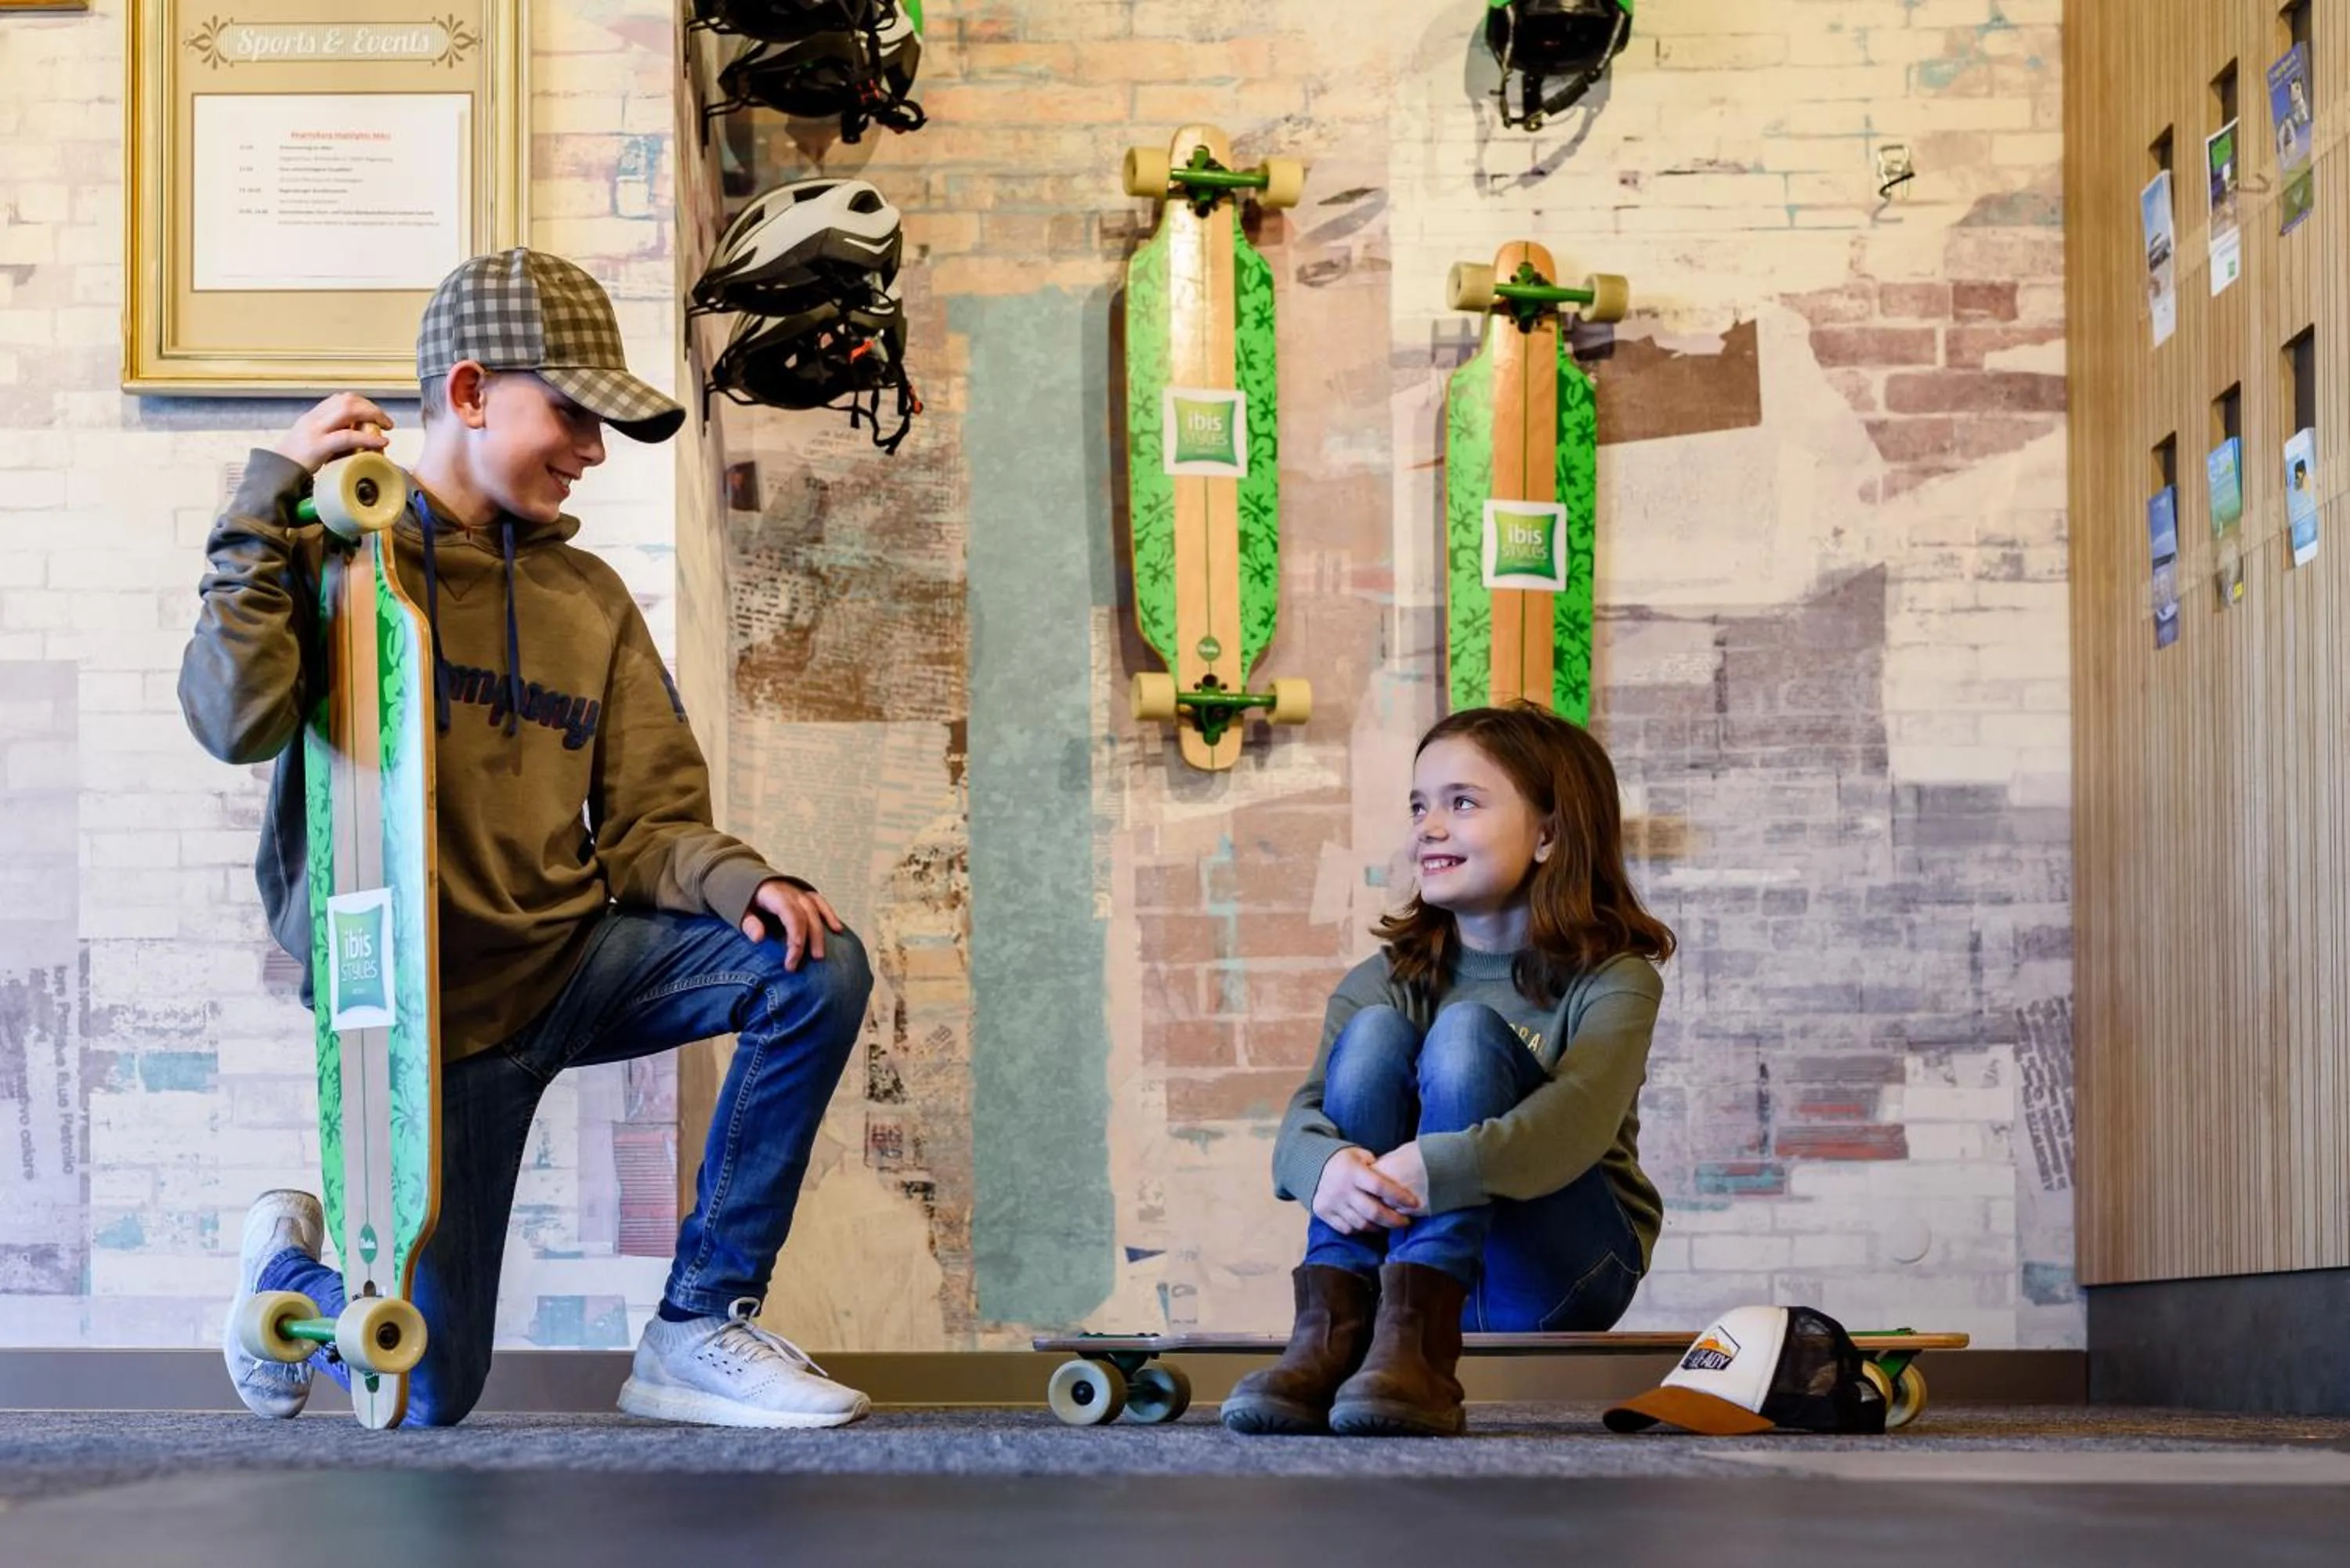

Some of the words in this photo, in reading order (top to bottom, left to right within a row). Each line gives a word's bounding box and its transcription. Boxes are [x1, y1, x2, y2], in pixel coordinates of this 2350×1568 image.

[237, 28, 316, 62] Sports
[322, 27, 343, 53] &
[352, 27, 428, 53] Events
[1187, 410, 1223, 431] ibis
[1508, 522, 1542, 545] ibis
[345, 927, 372, 959] ibis
